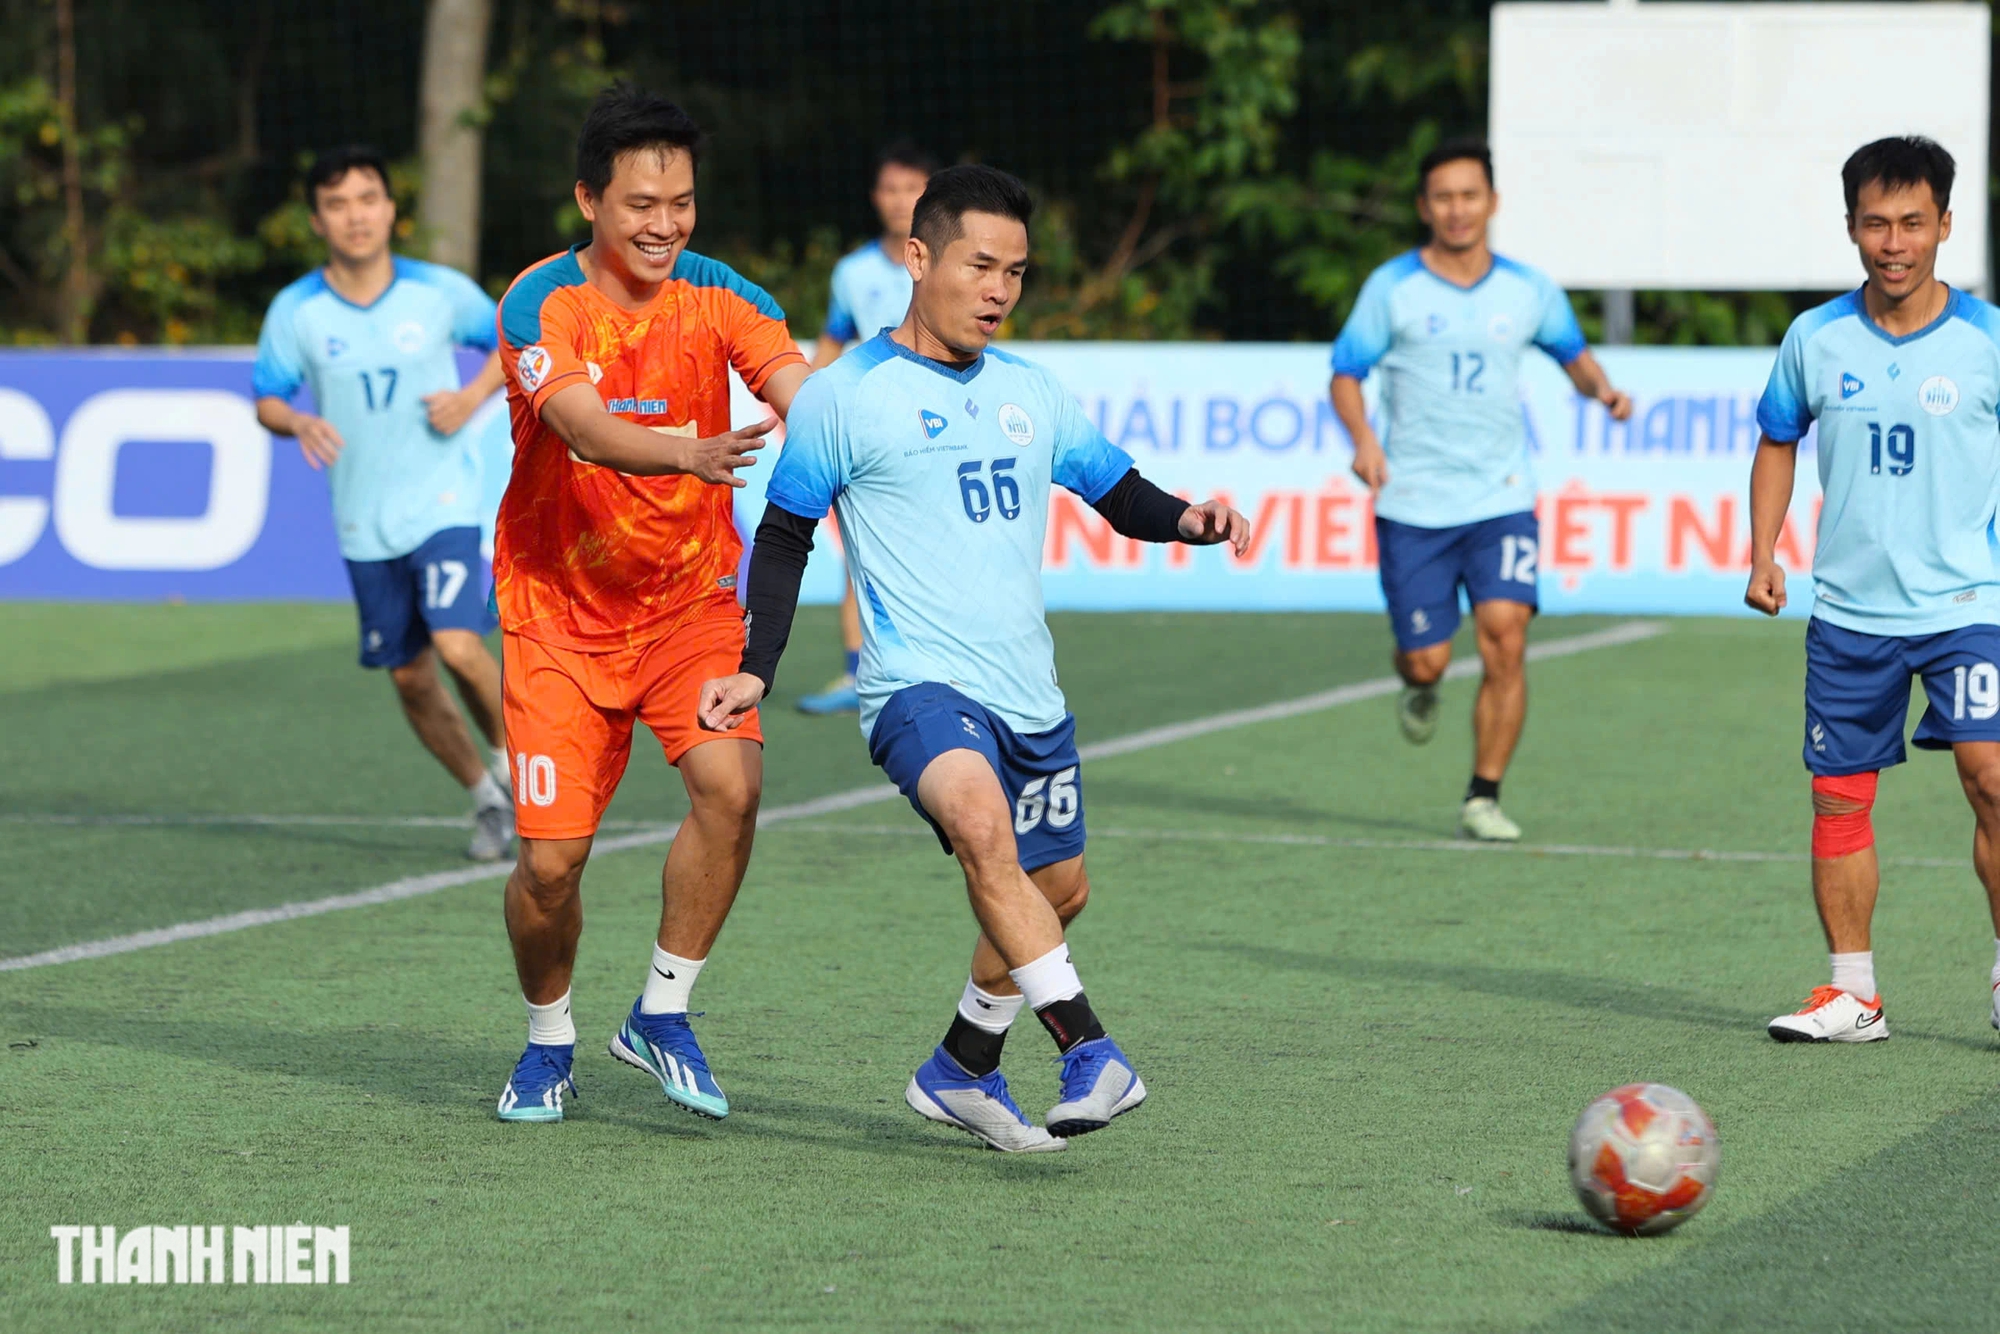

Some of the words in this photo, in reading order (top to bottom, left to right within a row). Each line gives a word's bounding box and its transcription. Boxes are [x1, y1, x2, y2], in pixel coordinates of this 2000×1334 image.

[358, 367, 398, 411] 17
[1452, 351, 1484, 392] 12
[925, 417, 943, 429] VBI
[1868, 421, 1914, 476] 19
[957, 457, 1020, 523] 66
[426, 560, 469, 609] 17
[1502, 534, 1537, 584] 12
[1954, 662, 2000, 720] 19
[517, 752, 557, 806] 10
[1014, 765, 1078, 835] 66
